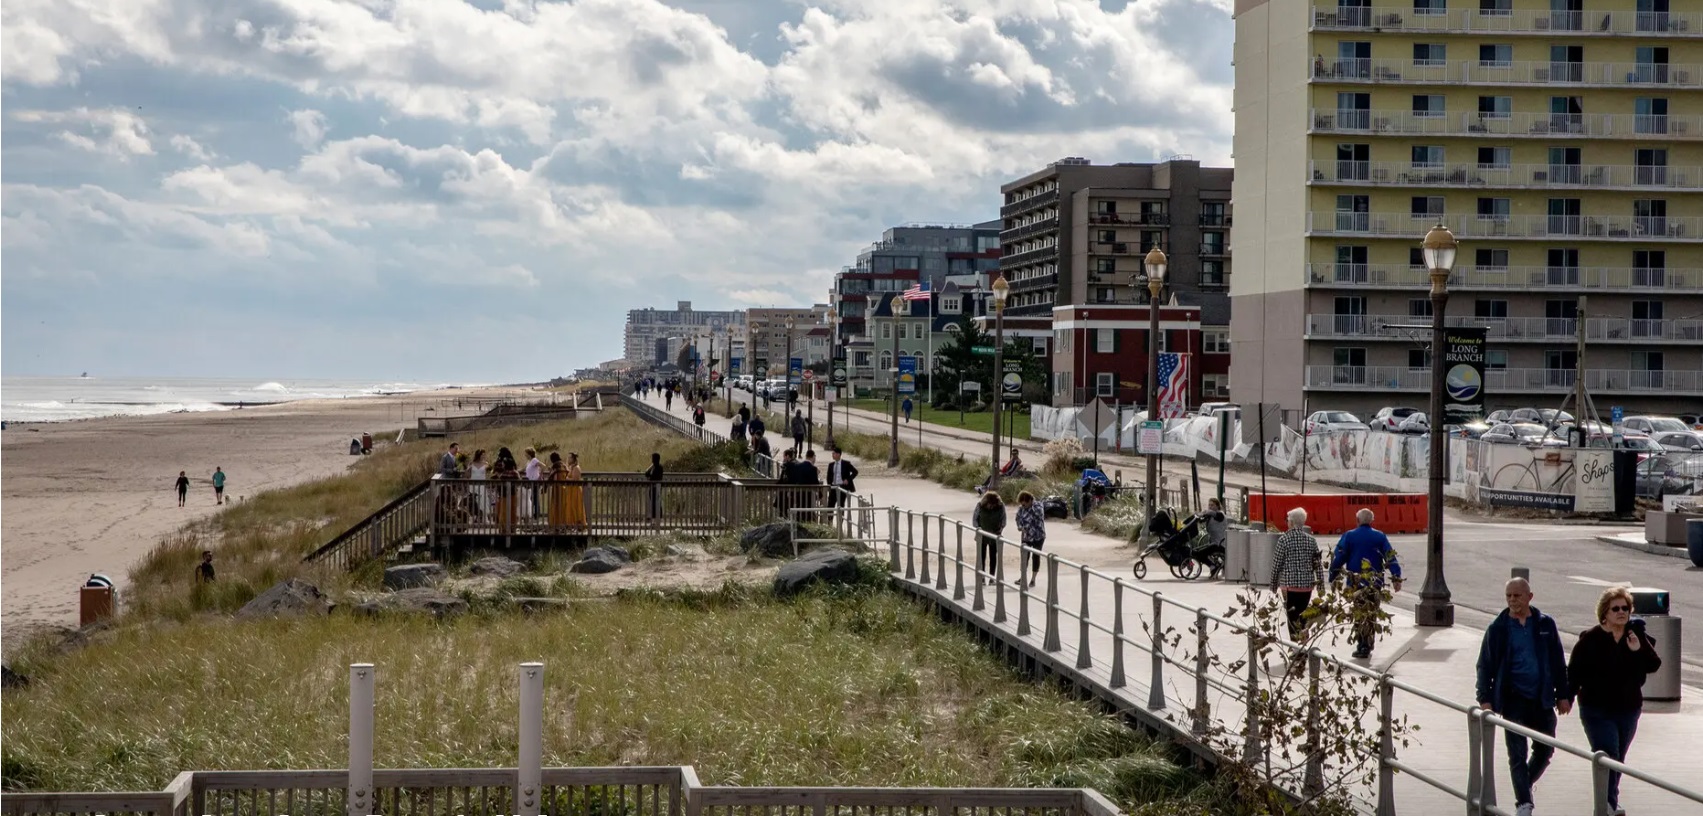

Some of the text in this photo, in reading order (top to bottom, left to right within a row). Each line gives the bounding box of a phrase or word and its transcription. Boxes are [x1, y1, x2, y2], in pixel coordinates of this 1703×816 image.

[1448, 336, 1475, 344] Welcome
[1451, 345, 1478, 353] LONG
[1446, 353, 1483, 362] BRANCH
[1582, 459, 1616, 484] Shops
[1534, 496, 1571, 505] AVAILABLE
